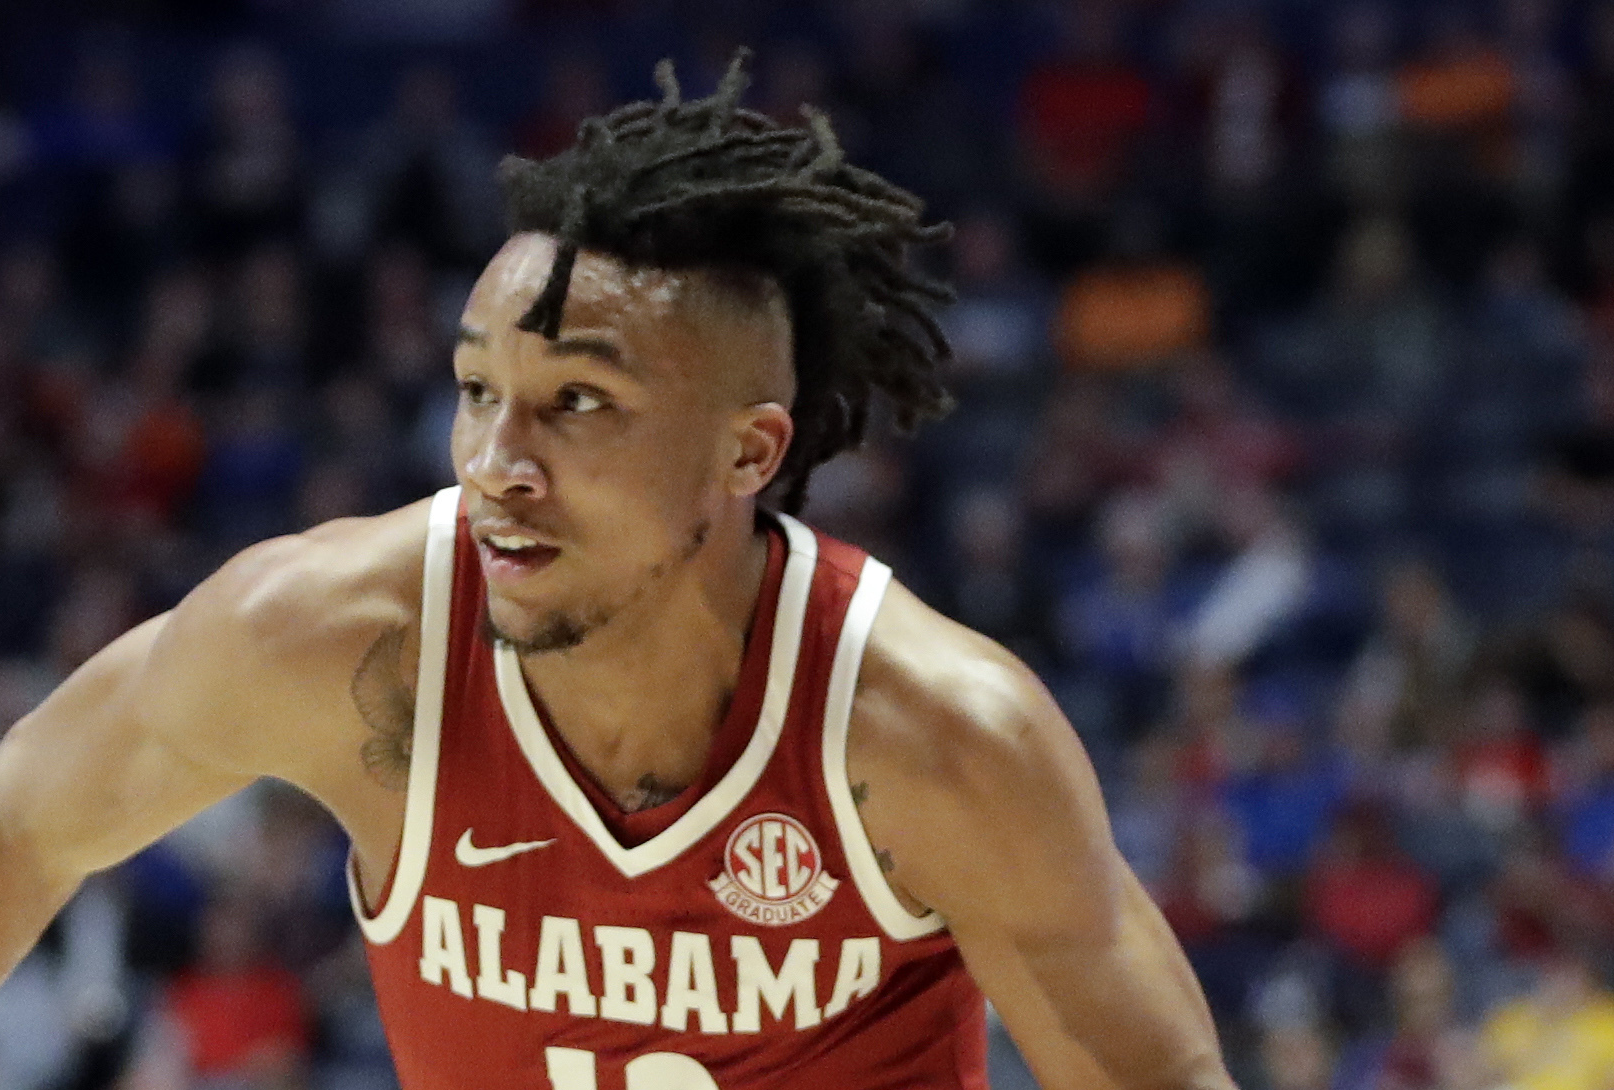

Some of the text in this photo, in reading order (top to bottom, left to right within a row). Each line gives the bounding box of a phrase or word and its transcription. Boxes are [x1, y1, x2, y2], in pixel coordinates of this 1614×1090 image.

[733, 821, 812, 898] SEC
[726, 891, 820, 921] GRADUATE
[420, 895, 881, 1034] ALABAMA
